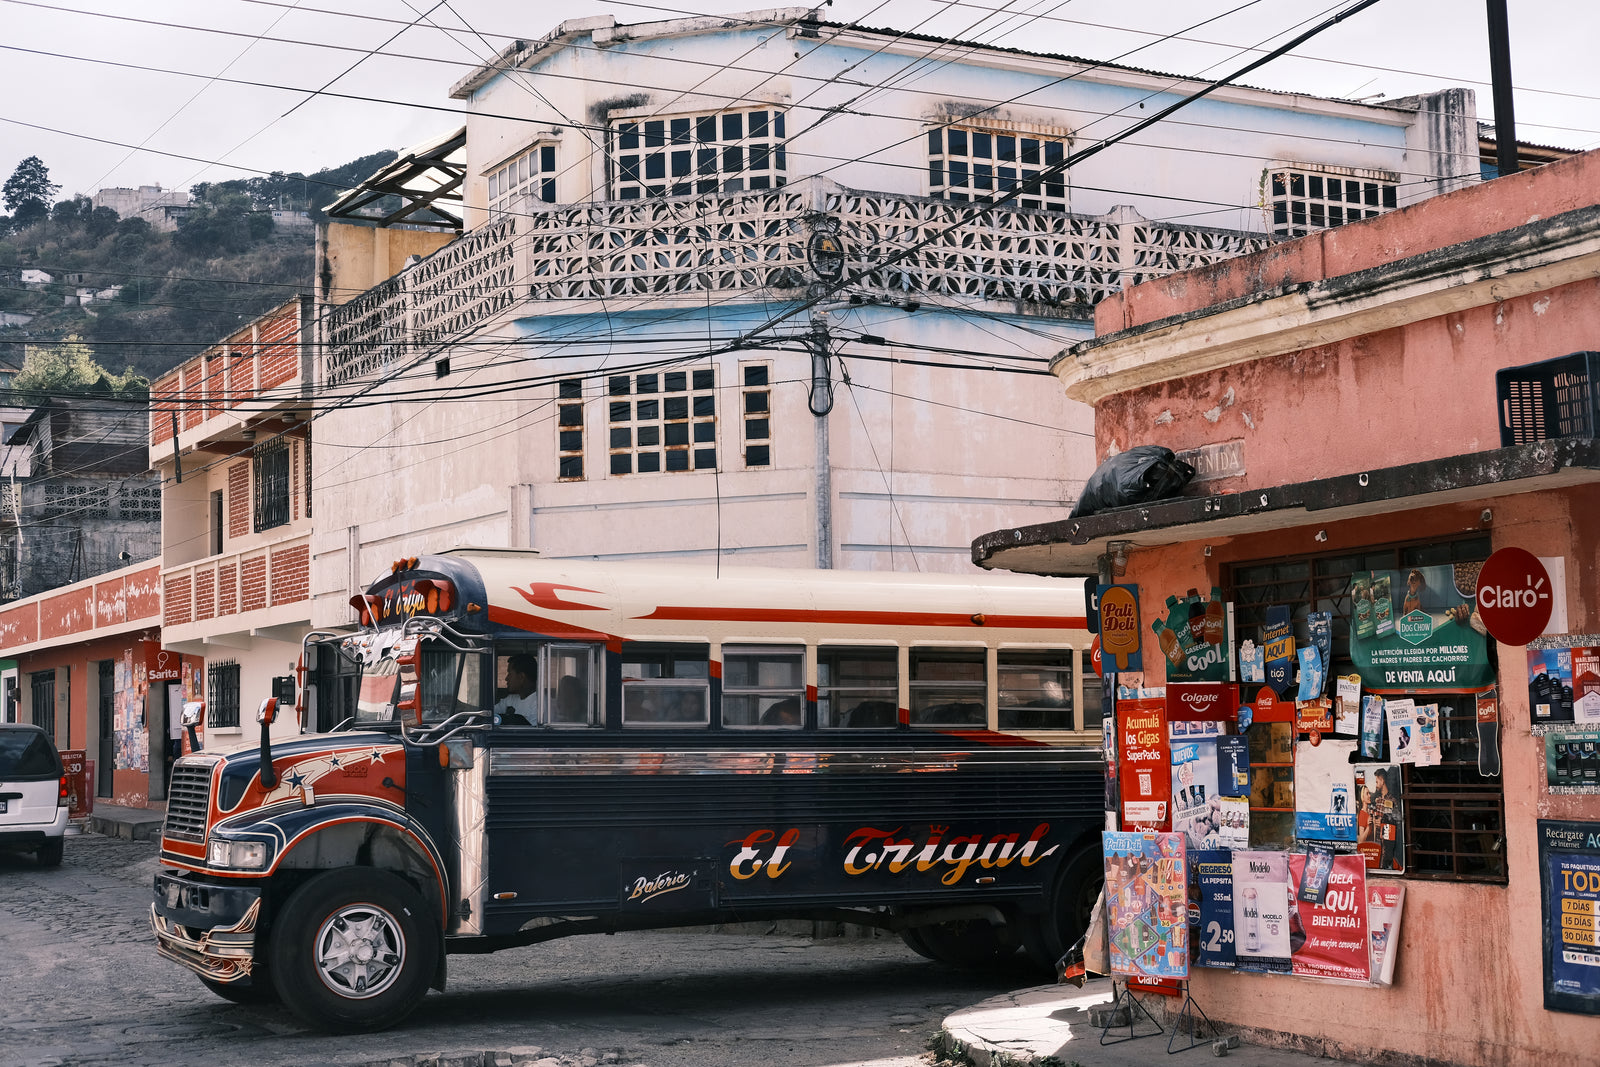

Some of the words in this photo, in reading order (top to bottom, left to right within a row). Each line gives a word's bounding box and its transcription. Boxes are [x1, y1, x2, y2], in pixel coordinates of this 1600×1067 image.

[1184, 451, 1239, 474] VENIDA
[396, 581, 425, 617] Triga
[1479, 585, 1538, 609] Claro
[1103, 602, 1133, 617] Pali
[1104, 616, 1135, 631] Deli
[1263, 625, 1289, 641] Internet
[1267, 639, 1286, 658] AQUÍ
[1379, 648, 1403, 656] NUTRICIÓN
[1439, 645, 1468, 654] MILLONES
[149, 670, 178, 680] Sarita
[1385, 671, 1396, 683] DE
[1397, 670, 1425, 683] VENTA
[1427, 666, 1456, 683] AQUÍ
[1181, 692, 1218, 704] Colgate
[1126, 714, 1160, 730] Acumulá
[1297, 719, 1331, 730] SuperPacks
[1126, 731, 1136, 745] los
[1138, 730, 1160, 747] Gigas
[1126, 748, 1160, 763] SuperPacks
[1173, 746, 1194, 763] NUEVOS
[1325, 814, 1353, 827] TECATE
[1546, 828, 1584, 841] Recárgate
[723, 829, 800, 881] El
[844, 822, 1060, 886] Trigal
[1200, 864, 1232, 874] REGRESÓ
[1249, 861, 1271, 873] Modelo
[1328, 871, 1353, 884] ÍDELA
[1567, 902, 1571, 910] 7
[1572, 900, 1590, 911] DÍAS
[1312, 915, 1334, 927] BIEN
[1565, 916, 1573, 925] 15
[1574, 916, 1592, 927] DÍAS
[1564, 931, 1573, 940] 30
[1575, 930, 1593, 942] DÍAS
[1320, 939, 1337, 949] mejor
[1338, 939, 1363, 952] cerveza!
[1308, 963, 1341, 971] PRODUCTO
[1344, 966, 1366, 974] CAUSA
